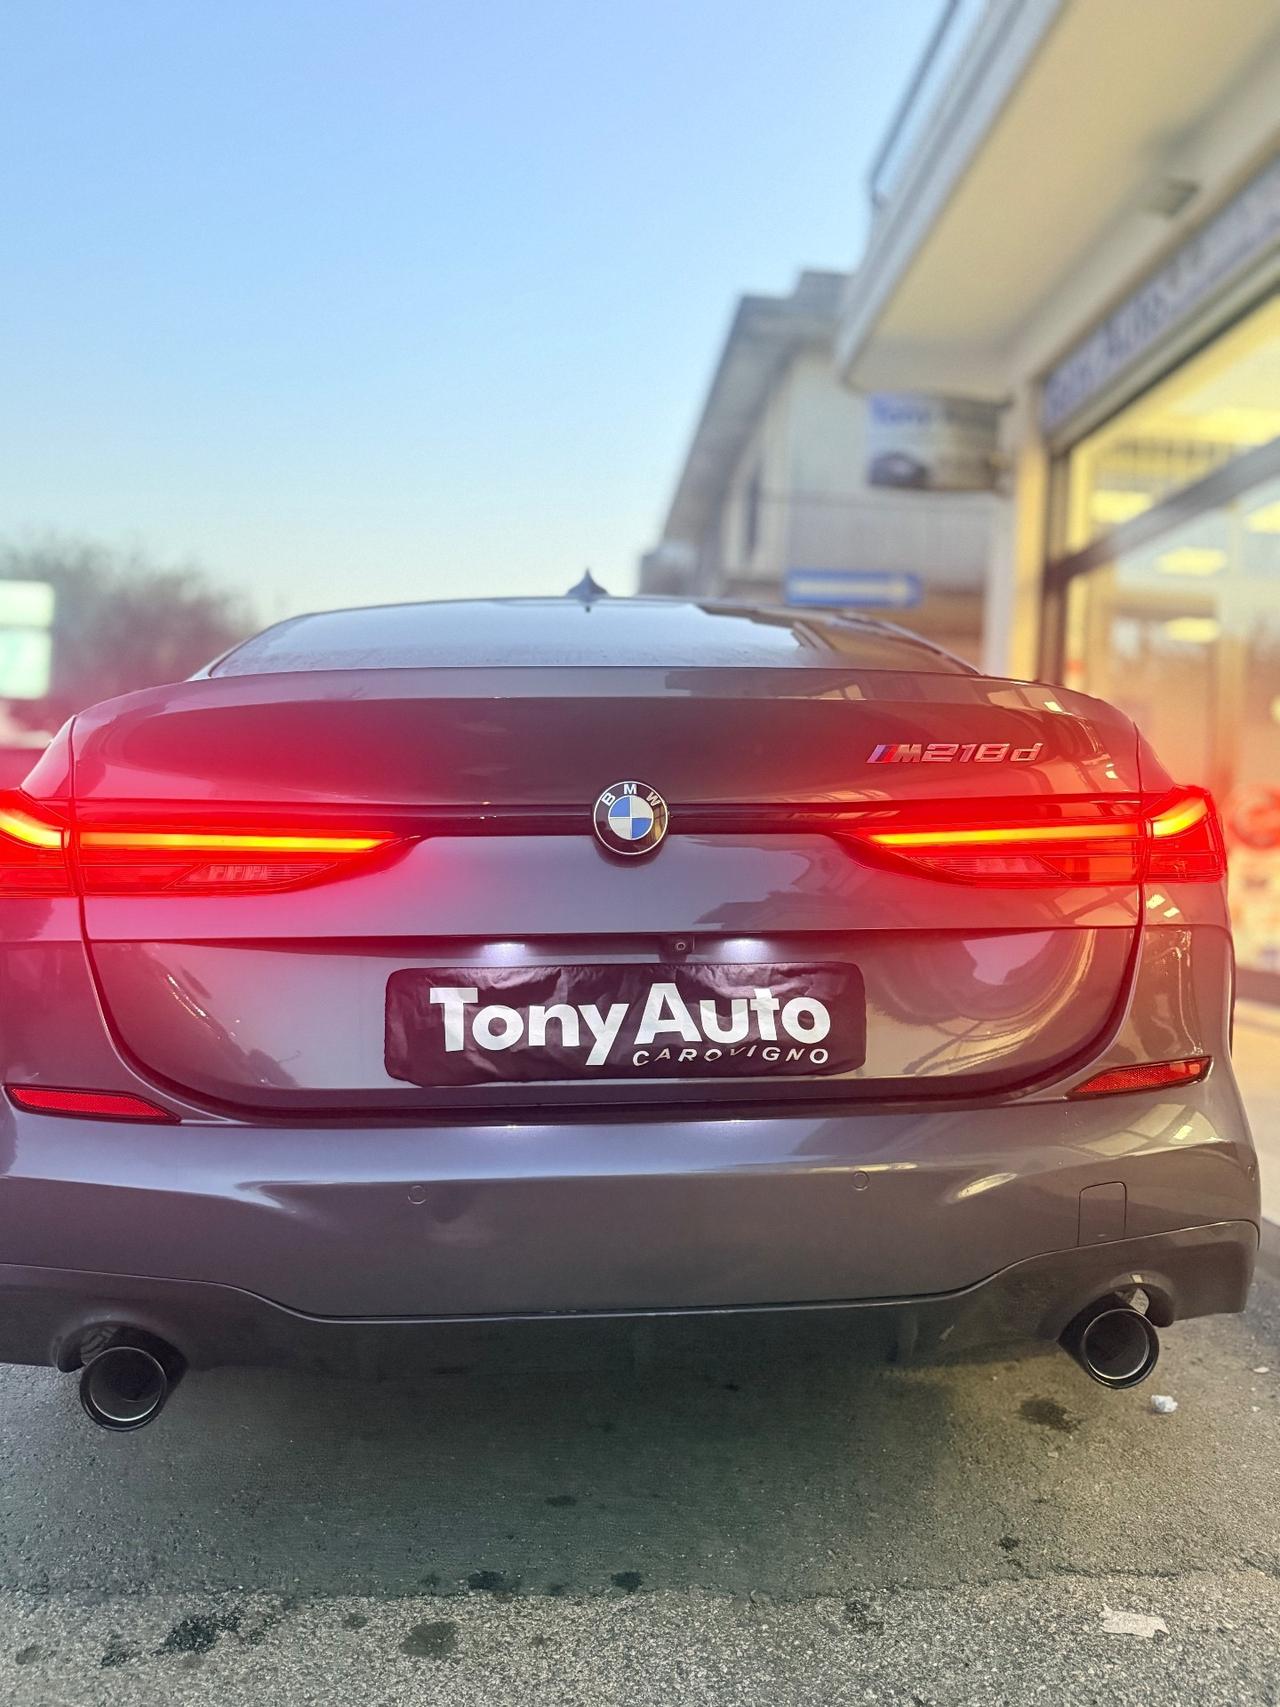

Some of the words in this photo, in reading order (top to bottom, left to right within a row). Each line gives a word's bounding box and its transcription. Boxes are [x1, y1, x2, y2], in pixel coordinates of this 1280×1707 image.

[601, 784, 661, 807] BMW
[430, 987, 629, 1065] Tony
[634, 983, 831, 1044] Auto
[633, 1045, 829, 1066] CAROVIGNO
